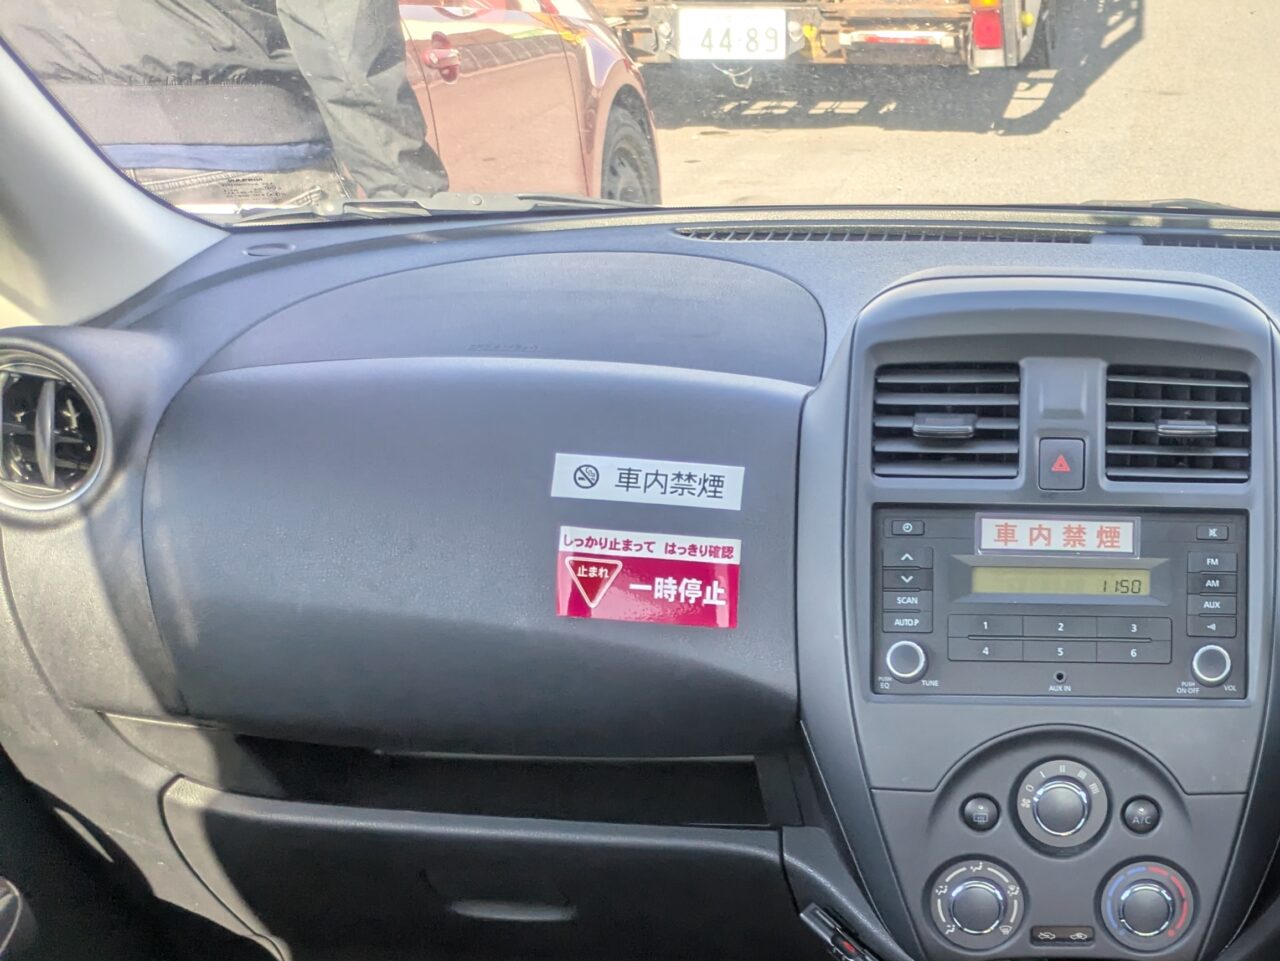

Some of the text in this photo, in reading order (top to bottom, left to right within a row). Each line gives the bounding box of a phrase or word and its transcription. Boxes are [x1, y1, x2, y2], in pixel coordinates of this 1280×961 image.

[615, 467, 725, 499] 車内禁煙
[994, 522, 1121, 549] 車内禁煙
[563, 534, 734, 560] しっかり止まって はっきり確認
[1206, 558, 1219, 566] FM
[577, 565, 610, 578] 止まれ
[629, 576, 727, 606] 一時停止
[896, 596, 918, 604] SCAN
[983, 621, 988, 630] 1
[1058, 623, 1064, 631] 2
[1131, 624, 1137, 632] 3
[982, 647, 989, 655] 4
[1057, 648, 1064, 656] 5
[1130, 649, 1137, 657] 6
[1223, 684, 1237, 692] VOL
[1132, 816, 1151, 825] A/C
